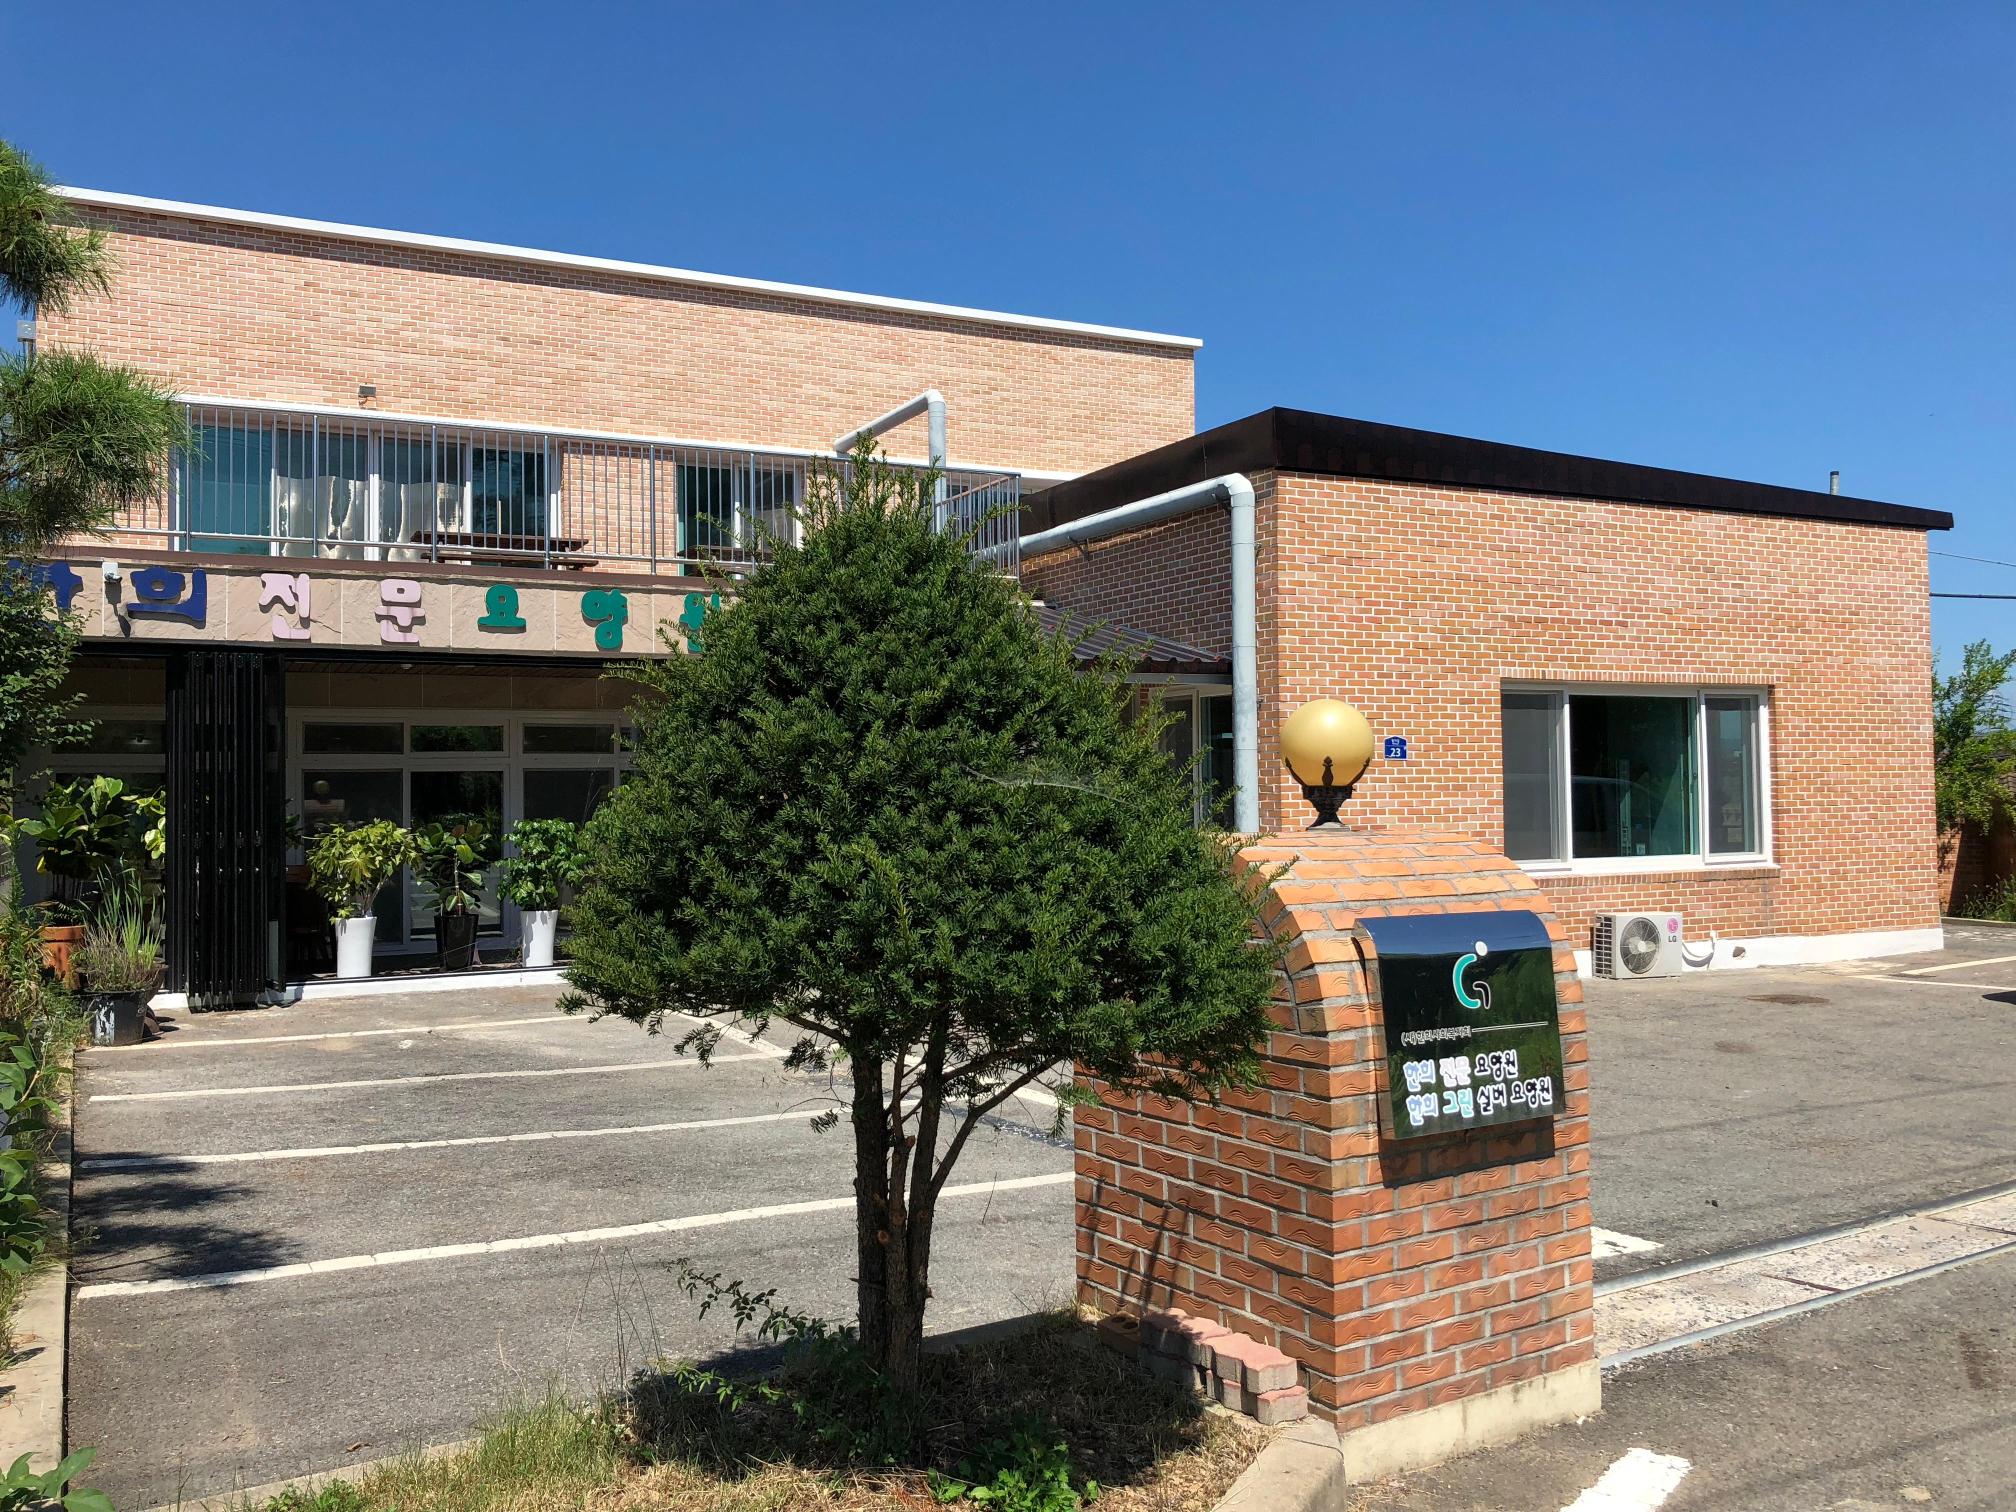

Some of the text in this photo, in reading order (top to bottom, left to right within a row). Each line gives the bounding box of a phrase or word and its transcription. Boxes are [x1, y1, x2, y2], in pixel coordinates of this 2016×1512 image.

[1390, 747, 1401, 757] 23
[1403, 1050, 1518, 1092] 한의 전문 요양원
[1406, 1076, 1553, 1126] 한의 그린 실버 요양원
